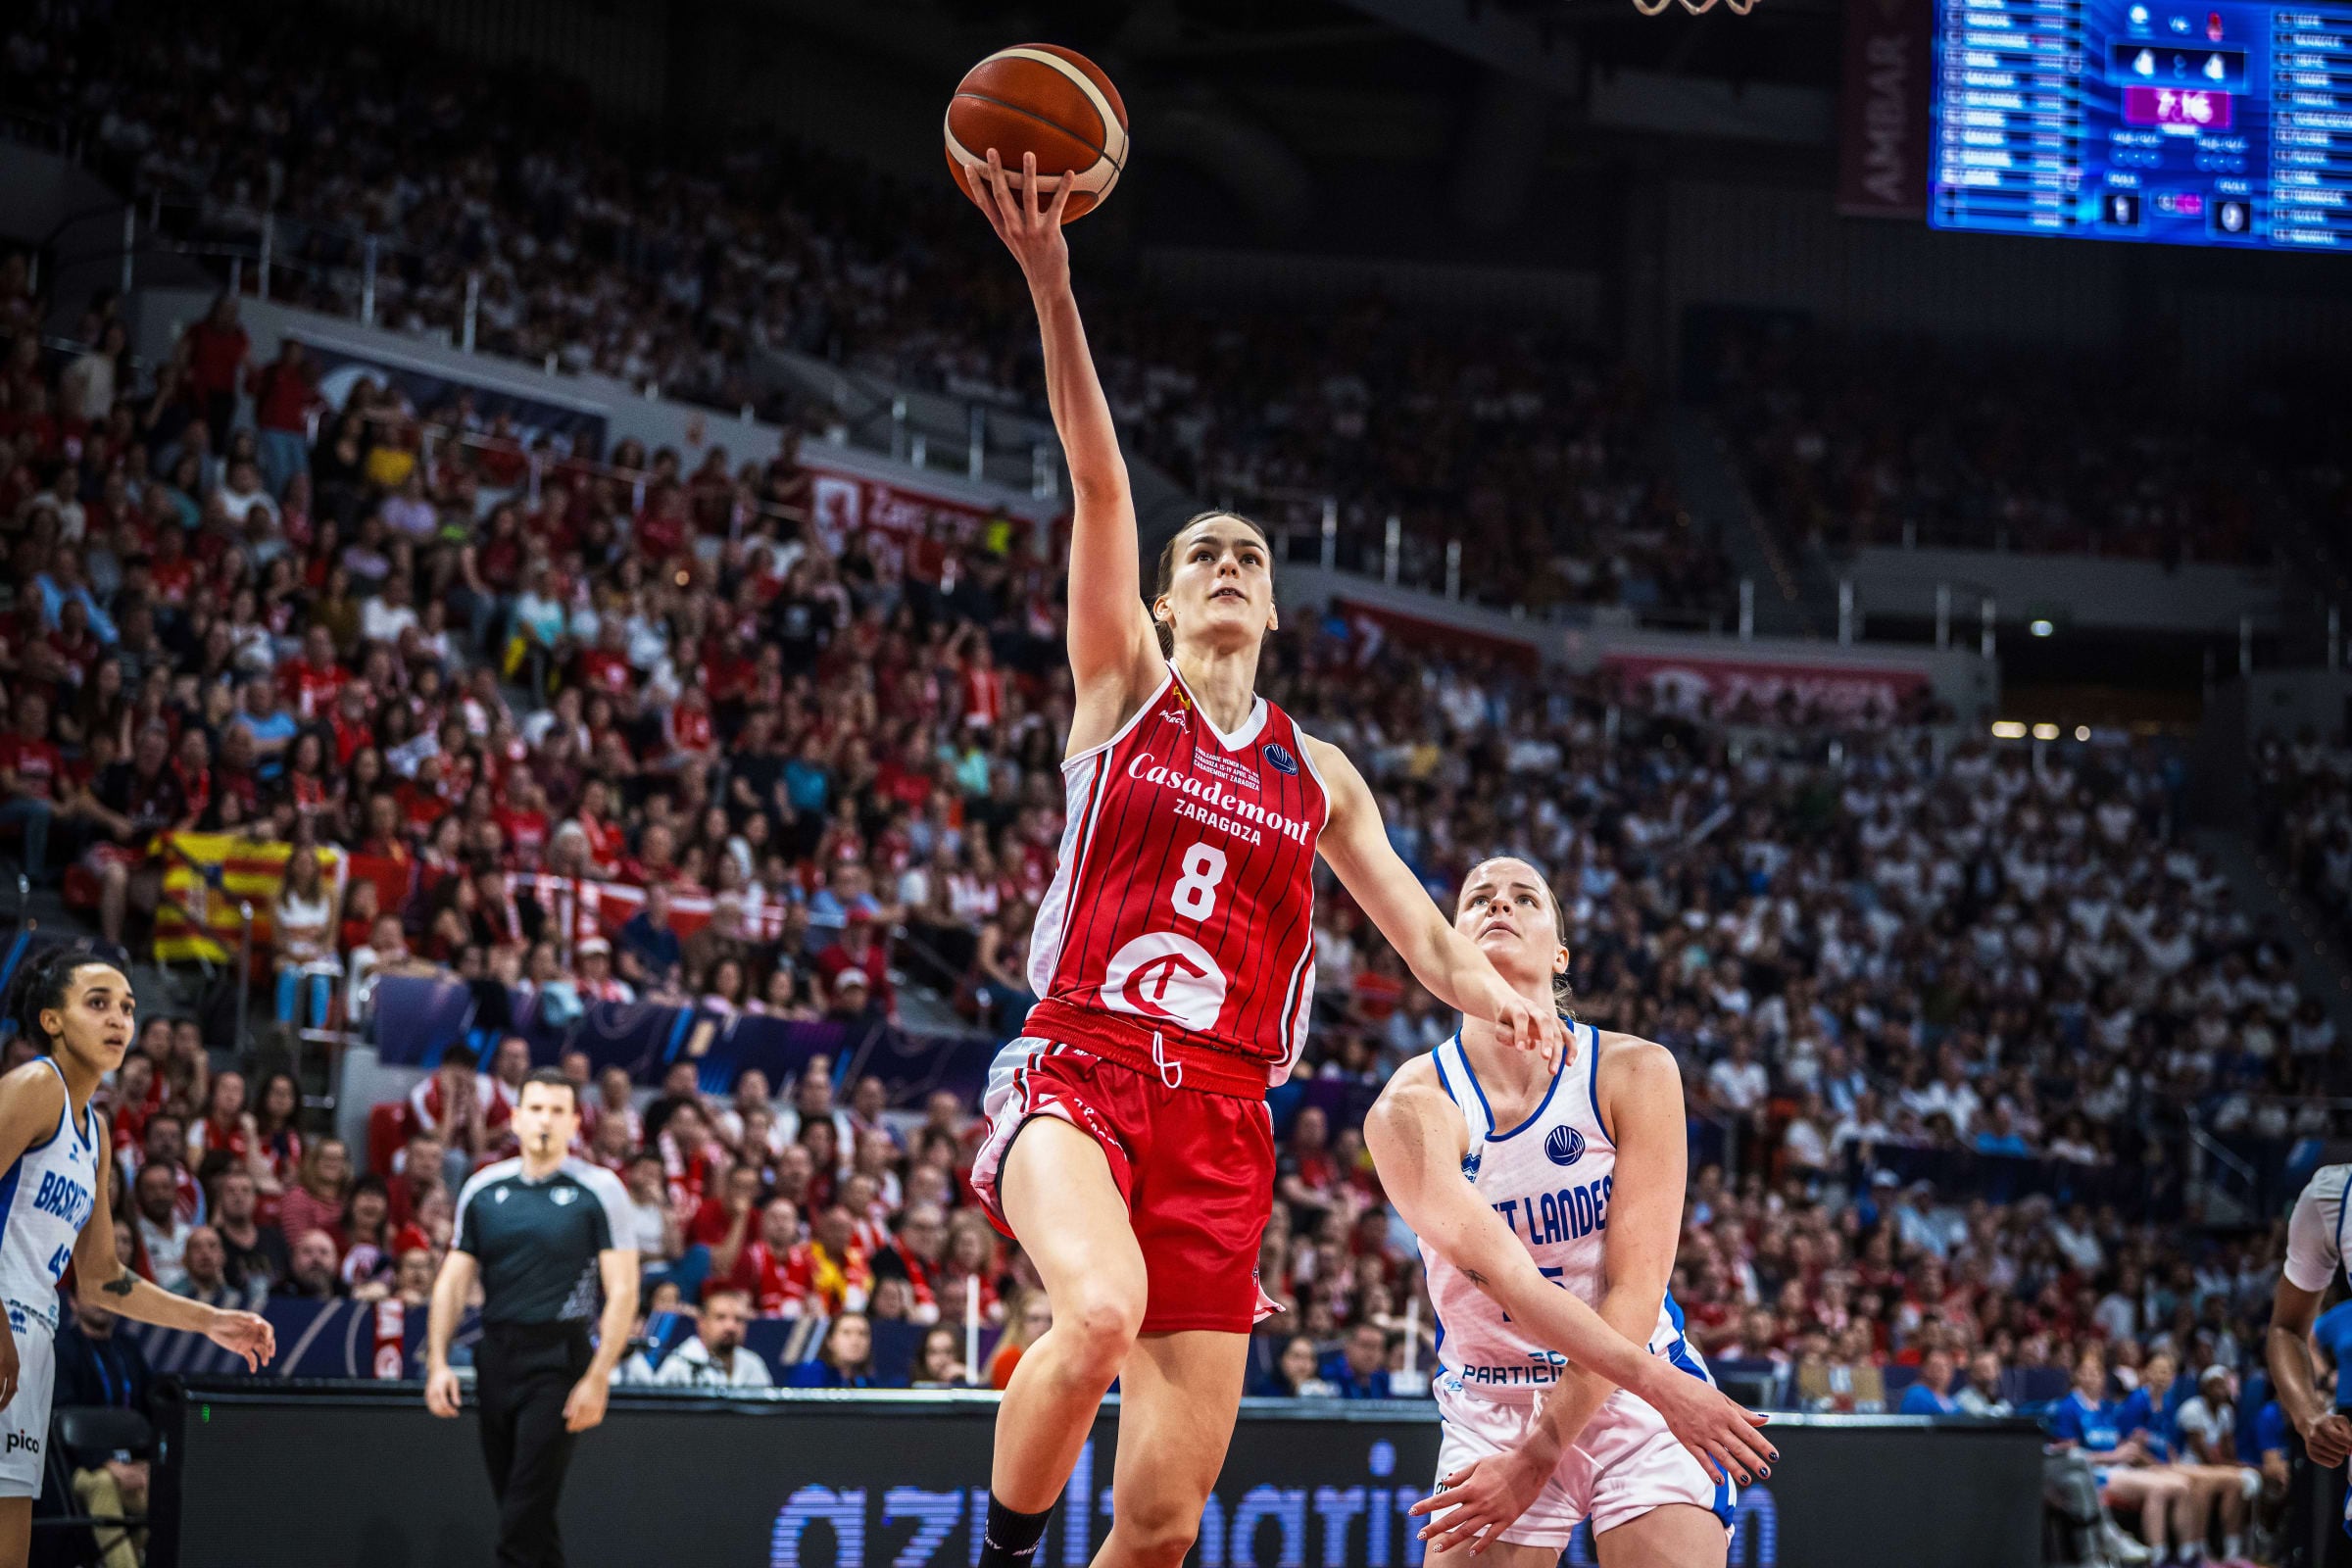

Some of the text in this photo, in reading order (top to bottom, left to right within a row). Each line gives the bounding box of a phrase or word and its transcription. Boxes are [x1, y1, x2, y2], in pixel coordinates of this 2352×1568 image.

[2132, 47, 2226, 83] 4 4
[1863, 31, 1910, 202] AMBAR
[1193, 759, 1260, 792] CASADEMONT ZARAGOZA
[1194, 752, 1218, 768] ZARAGOZA
[1219, 763, 1232, 773] 15-19
[1232, 769, 1248, 779] APRIL
[1128, 752, 1311, 846] Casademont
[1173, 798, 1261, 847] ZARAGOZA
[1170, 841, 1228, 922] 8
[6, 1429, 40, 1454] pico
